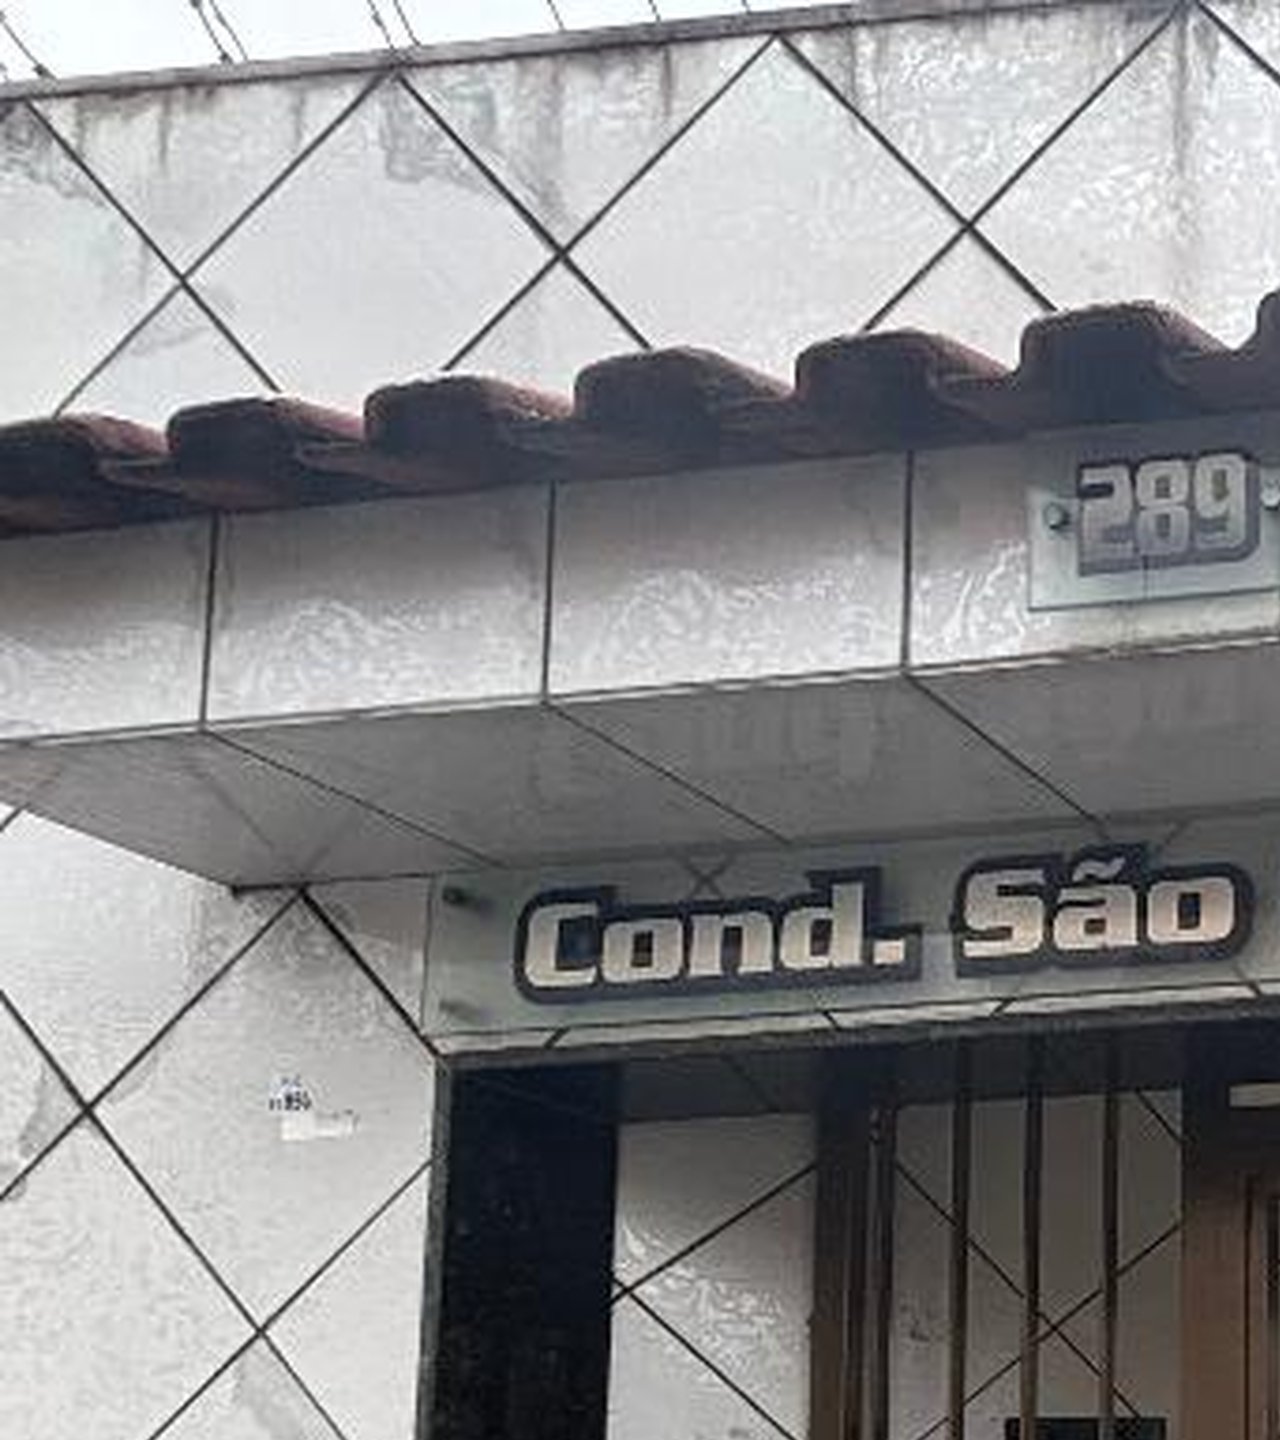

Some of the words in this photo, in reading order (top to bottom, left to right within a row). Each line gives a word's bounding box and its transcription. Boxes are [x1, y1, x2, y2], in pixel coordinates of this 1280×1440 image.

[1078, 452, 1254, 567] 289
[520, 872, 912, 995] Cond.
[958, 850, 1246, 966] São
